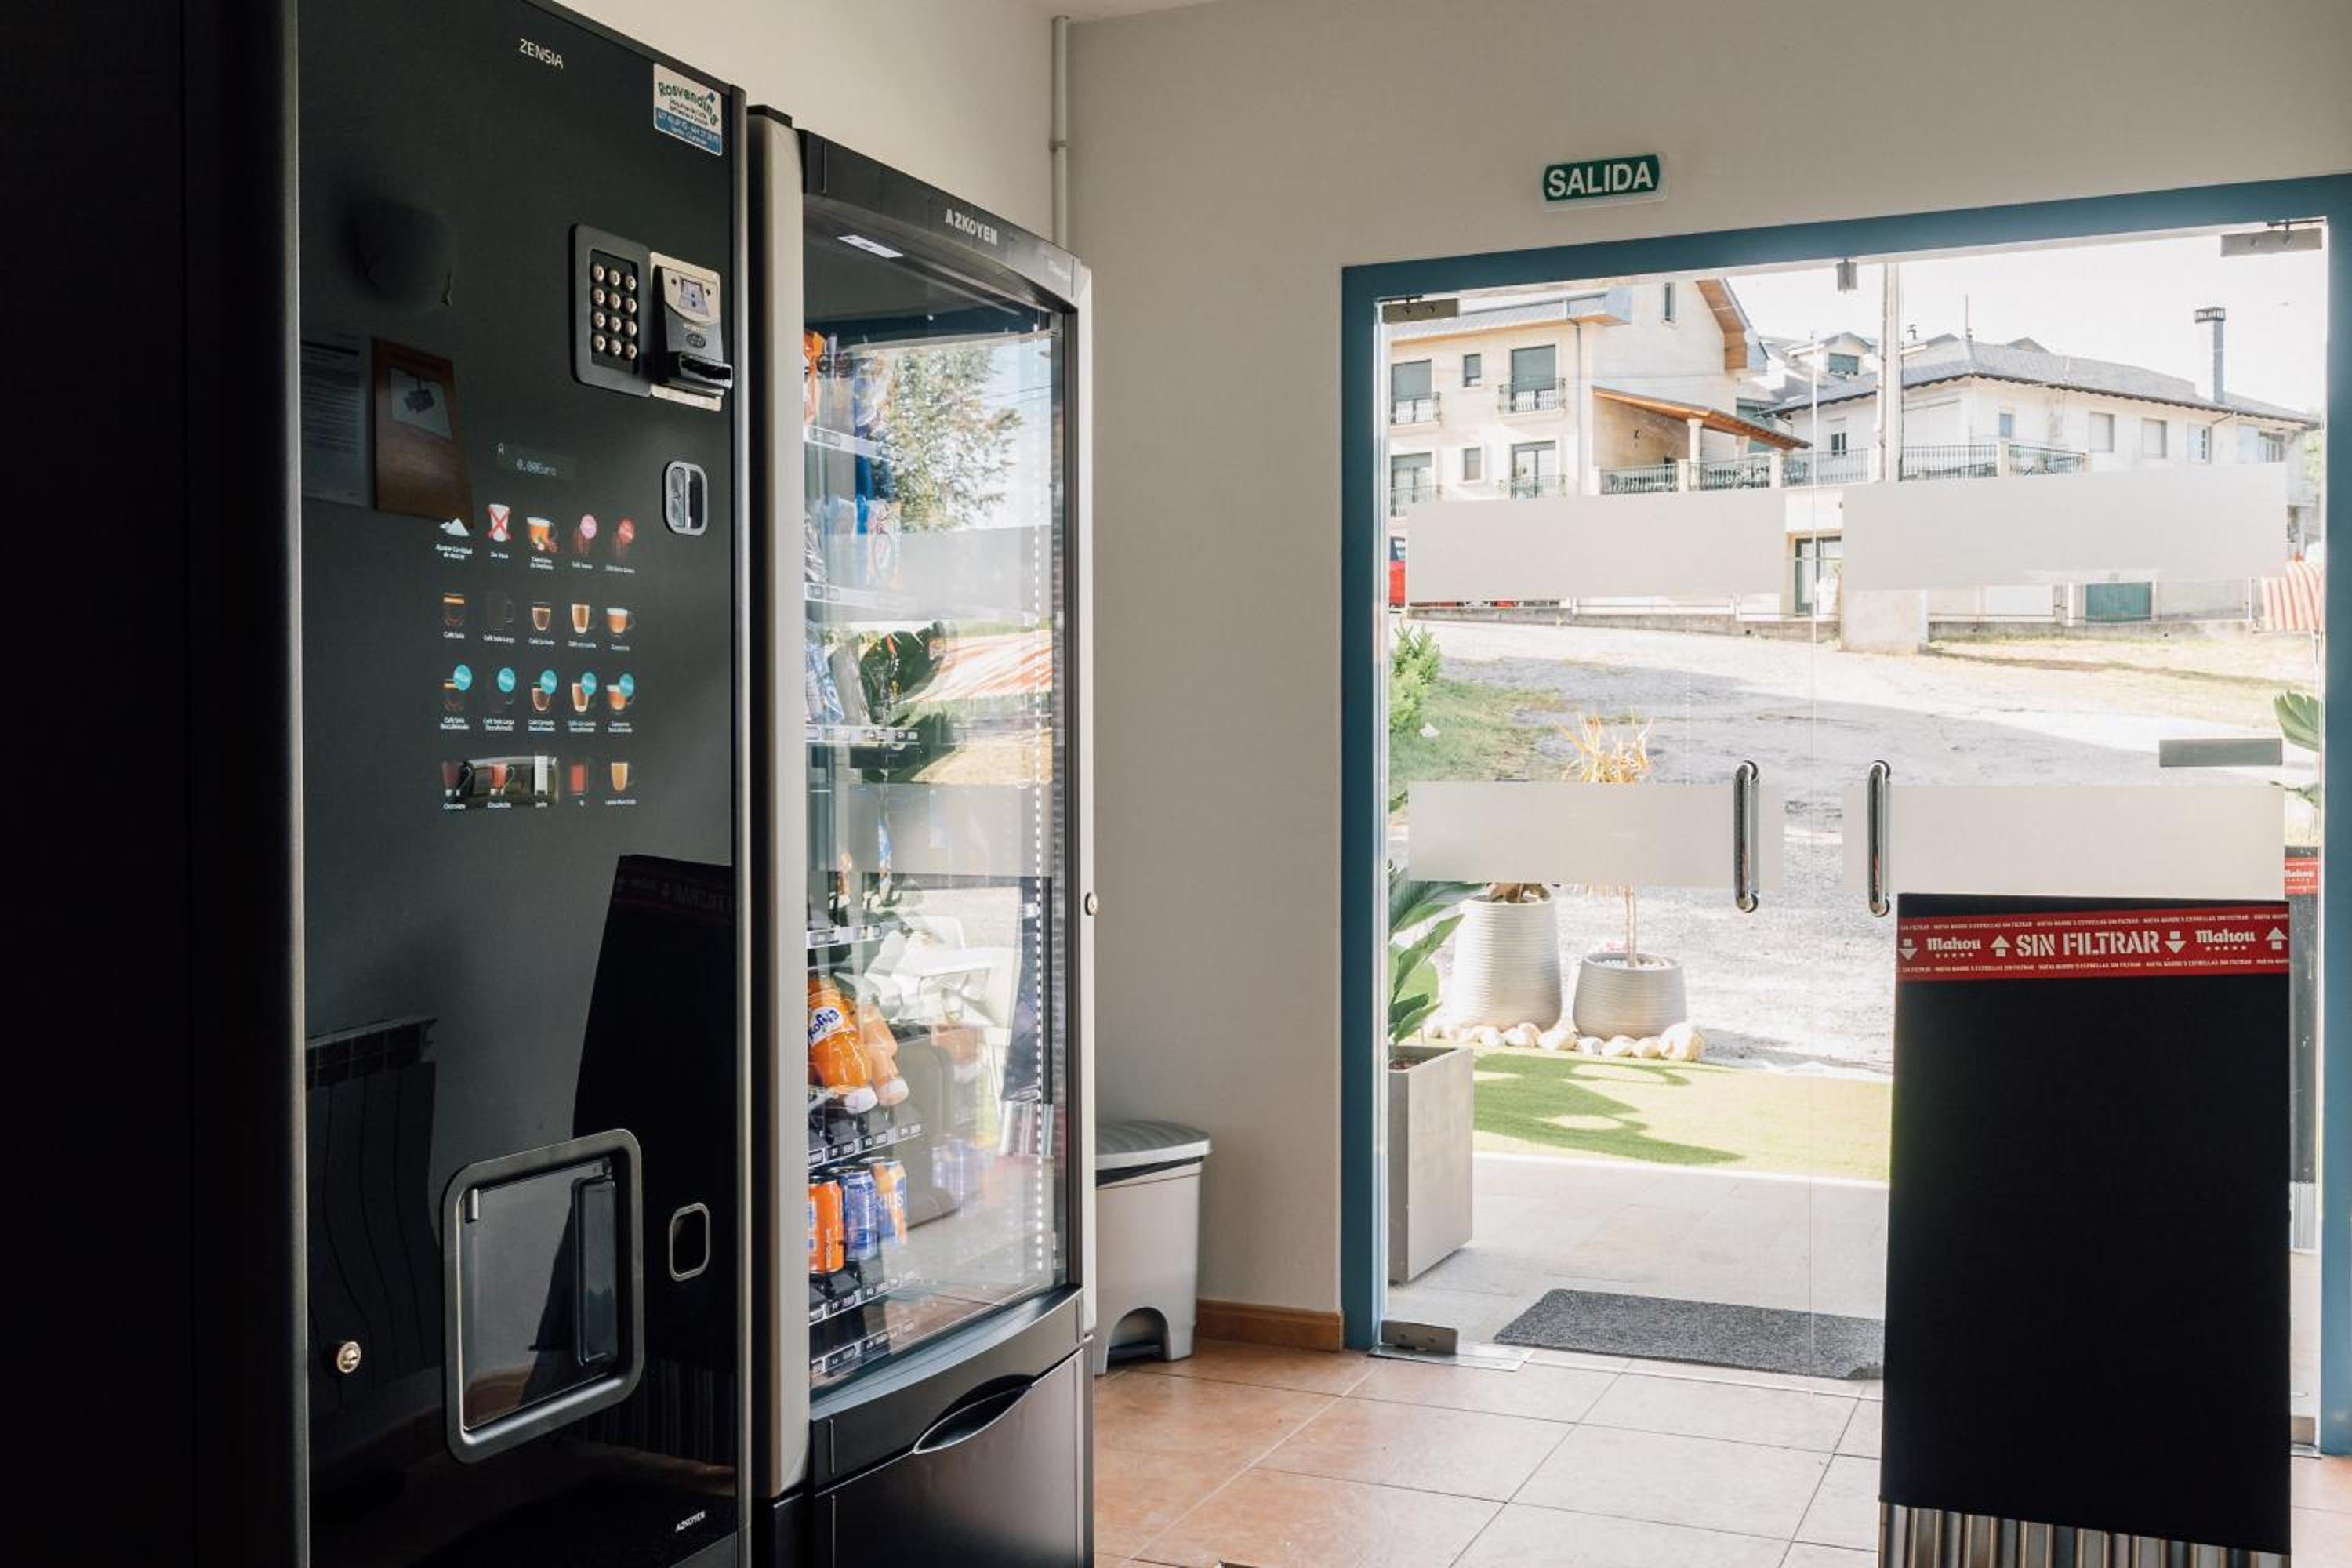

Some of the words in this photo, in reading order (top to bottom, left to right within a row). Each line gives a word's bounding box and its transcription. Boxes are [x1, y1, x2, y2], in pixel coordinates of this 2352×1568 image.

[519, 38, 564, 69] ZENSIA
[1548, 161, 1653, 197] SALIDA
[945, 209, 997, 246] AZKOYEN
[1926, 936, 1982, 951] Mahou
[2016, 933, 2056, 957] SIN
[2063, 931, 2160, 956] FILTRAR
[2195, 928, 2256, 943] Mahou
